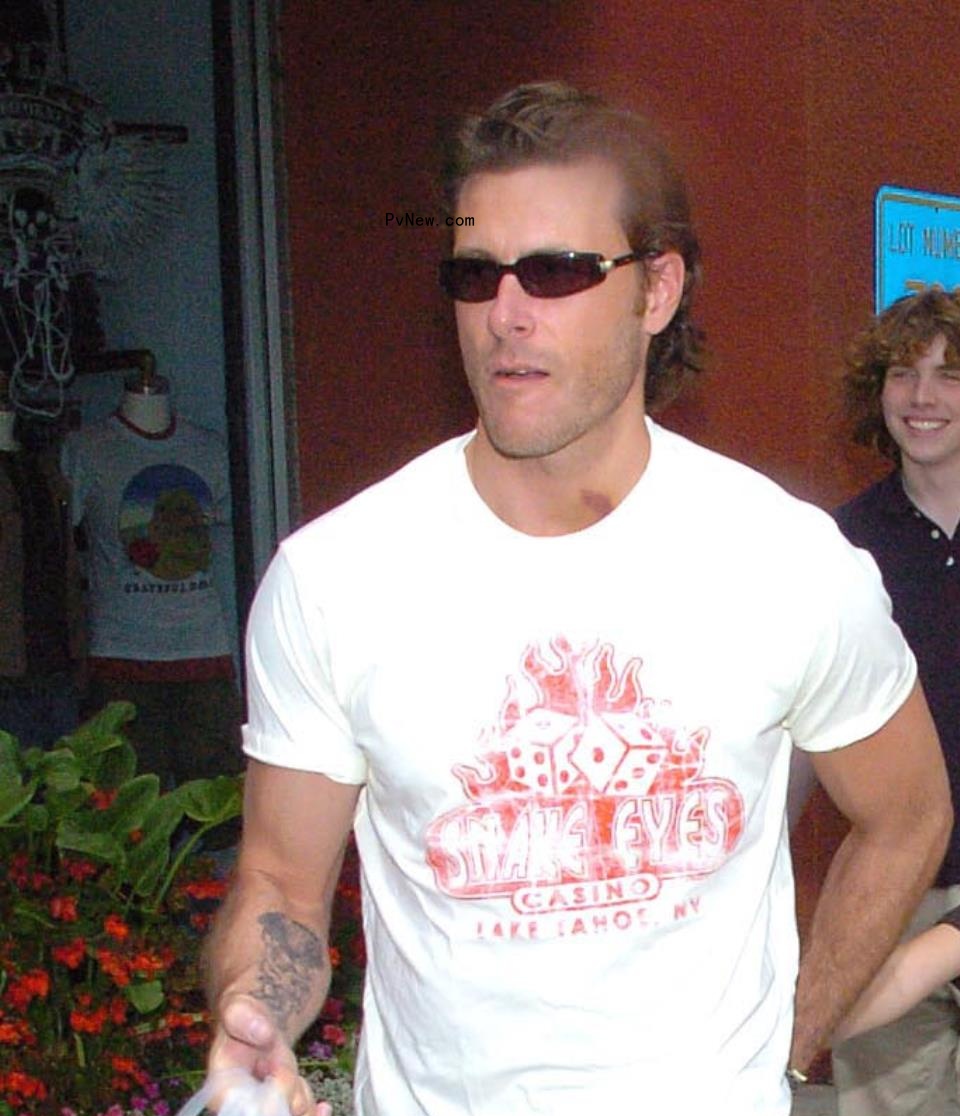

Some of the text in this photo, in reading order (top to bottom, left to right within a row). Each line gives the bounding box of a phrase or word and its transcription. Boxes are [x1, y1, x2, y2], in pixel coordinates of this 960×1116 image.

[889, 222, 914, 257] LOT
[611, 790, 728, 872] EYES
[521, 878, 652, 909] CASINO
[476, 921, 538, 940] LAKE
[673, 895, 702, 921] NV
